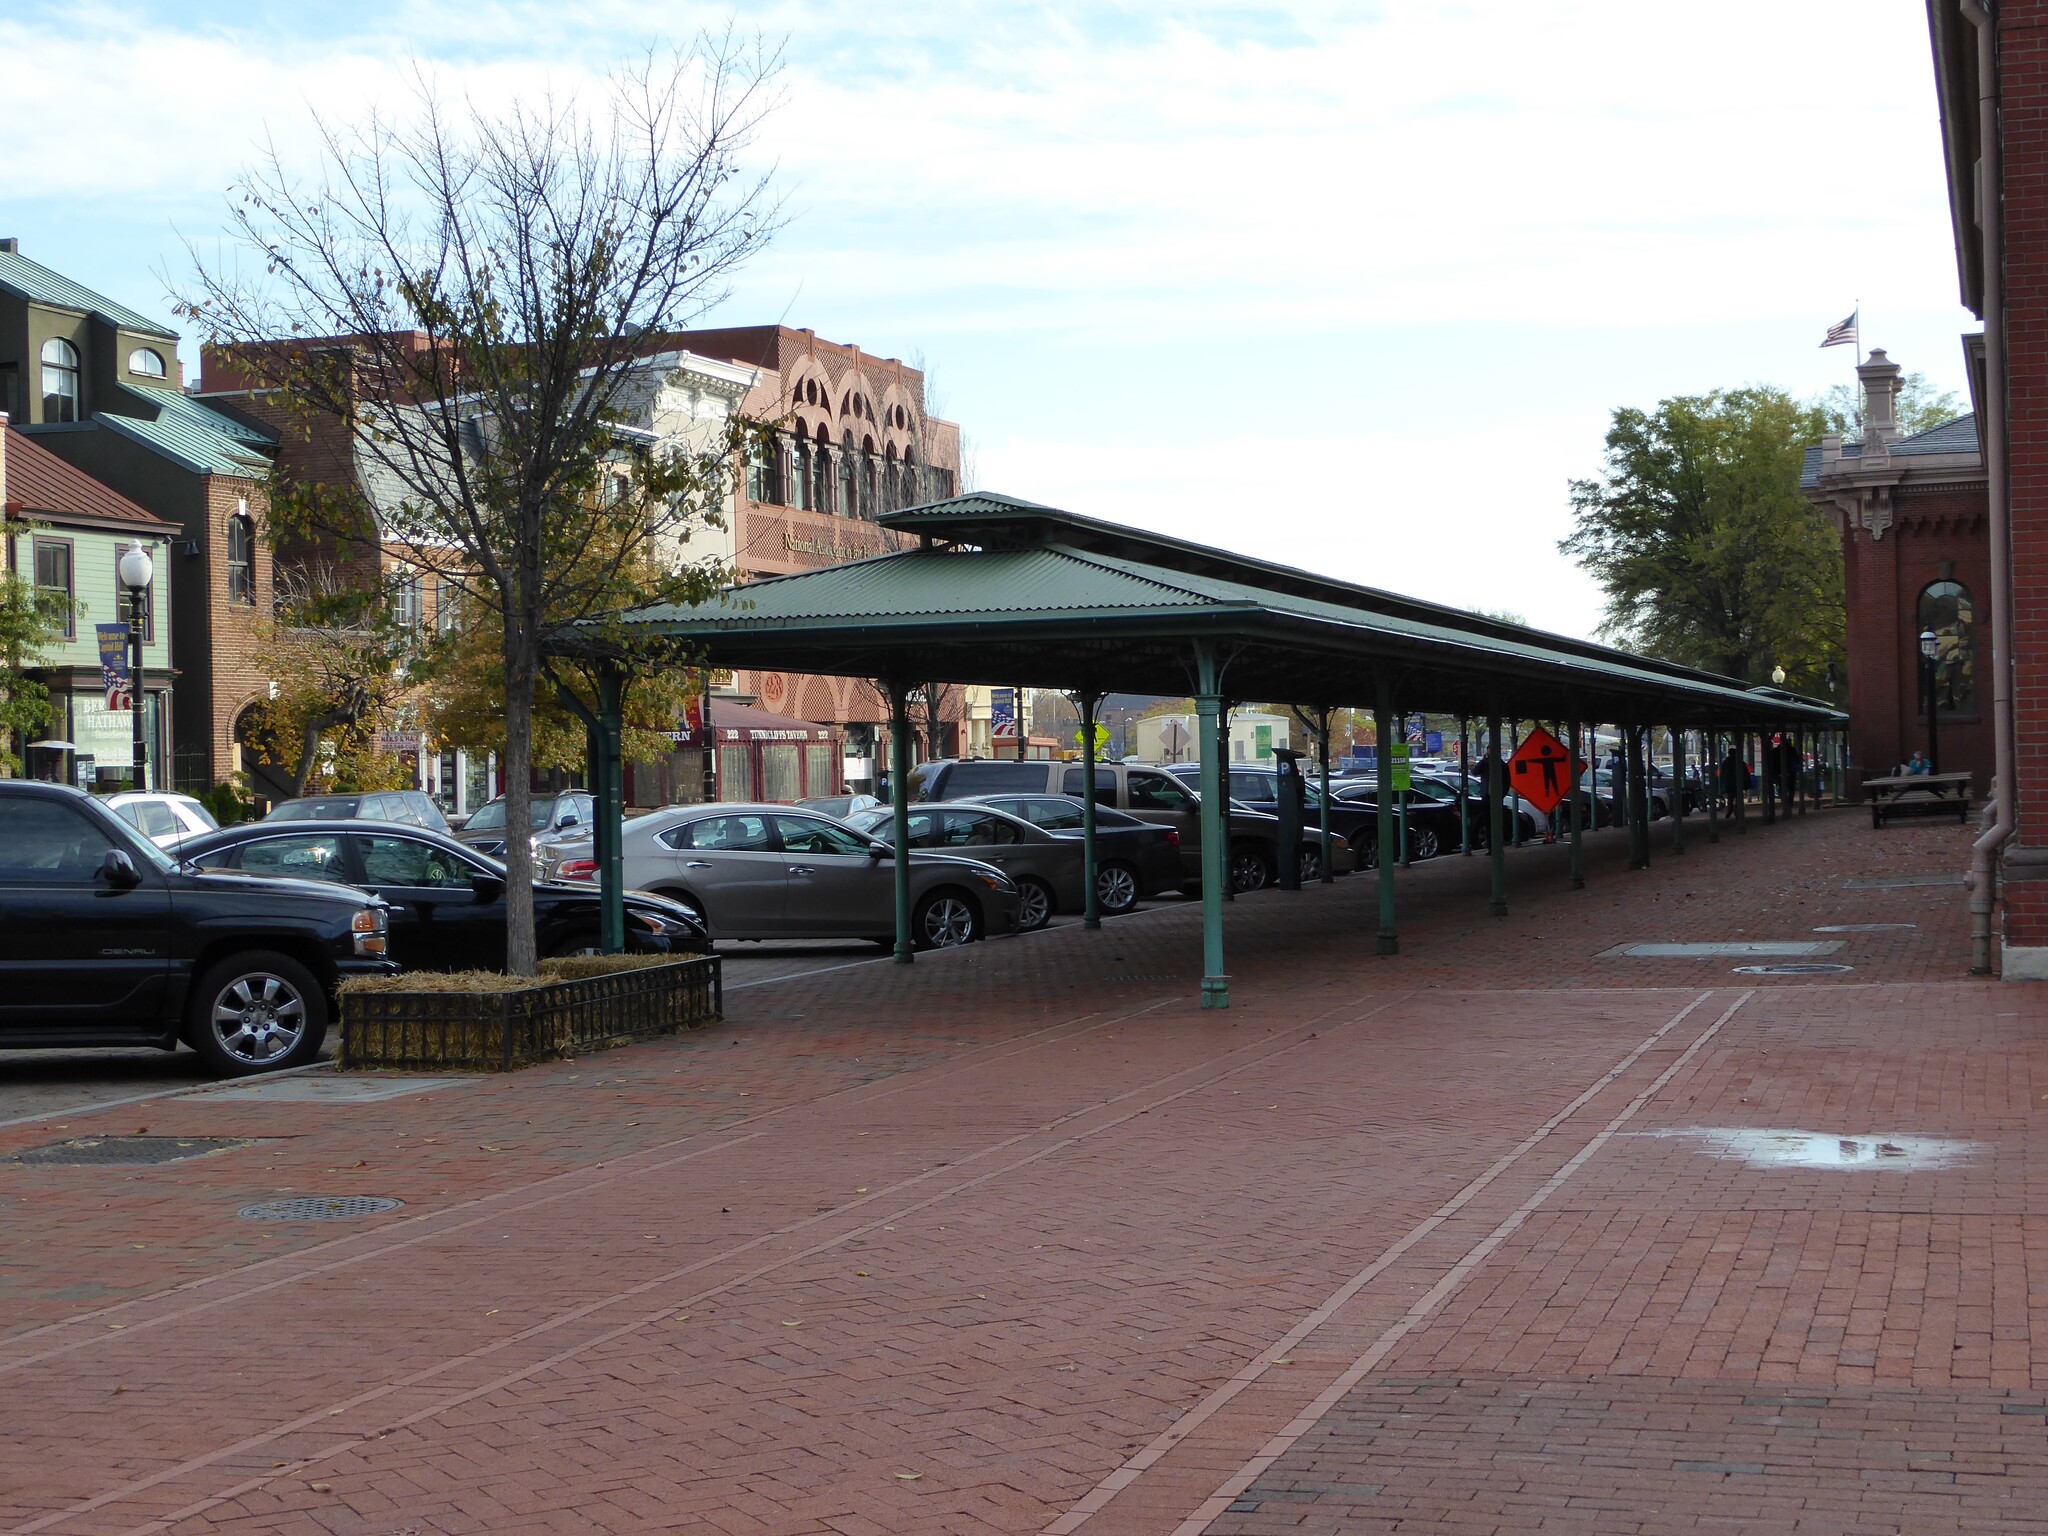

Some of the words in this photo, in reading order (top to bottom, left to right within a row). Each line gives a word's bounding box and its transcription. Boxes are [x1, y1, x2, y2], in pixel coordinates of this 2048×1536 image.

[784, 533, 815, 553] National
[727, 729, 739, 739] 222
[818, 730, 829, 740] 222
[1281, 762, 1290, 775] P
[881, 777, 888, 786] P
